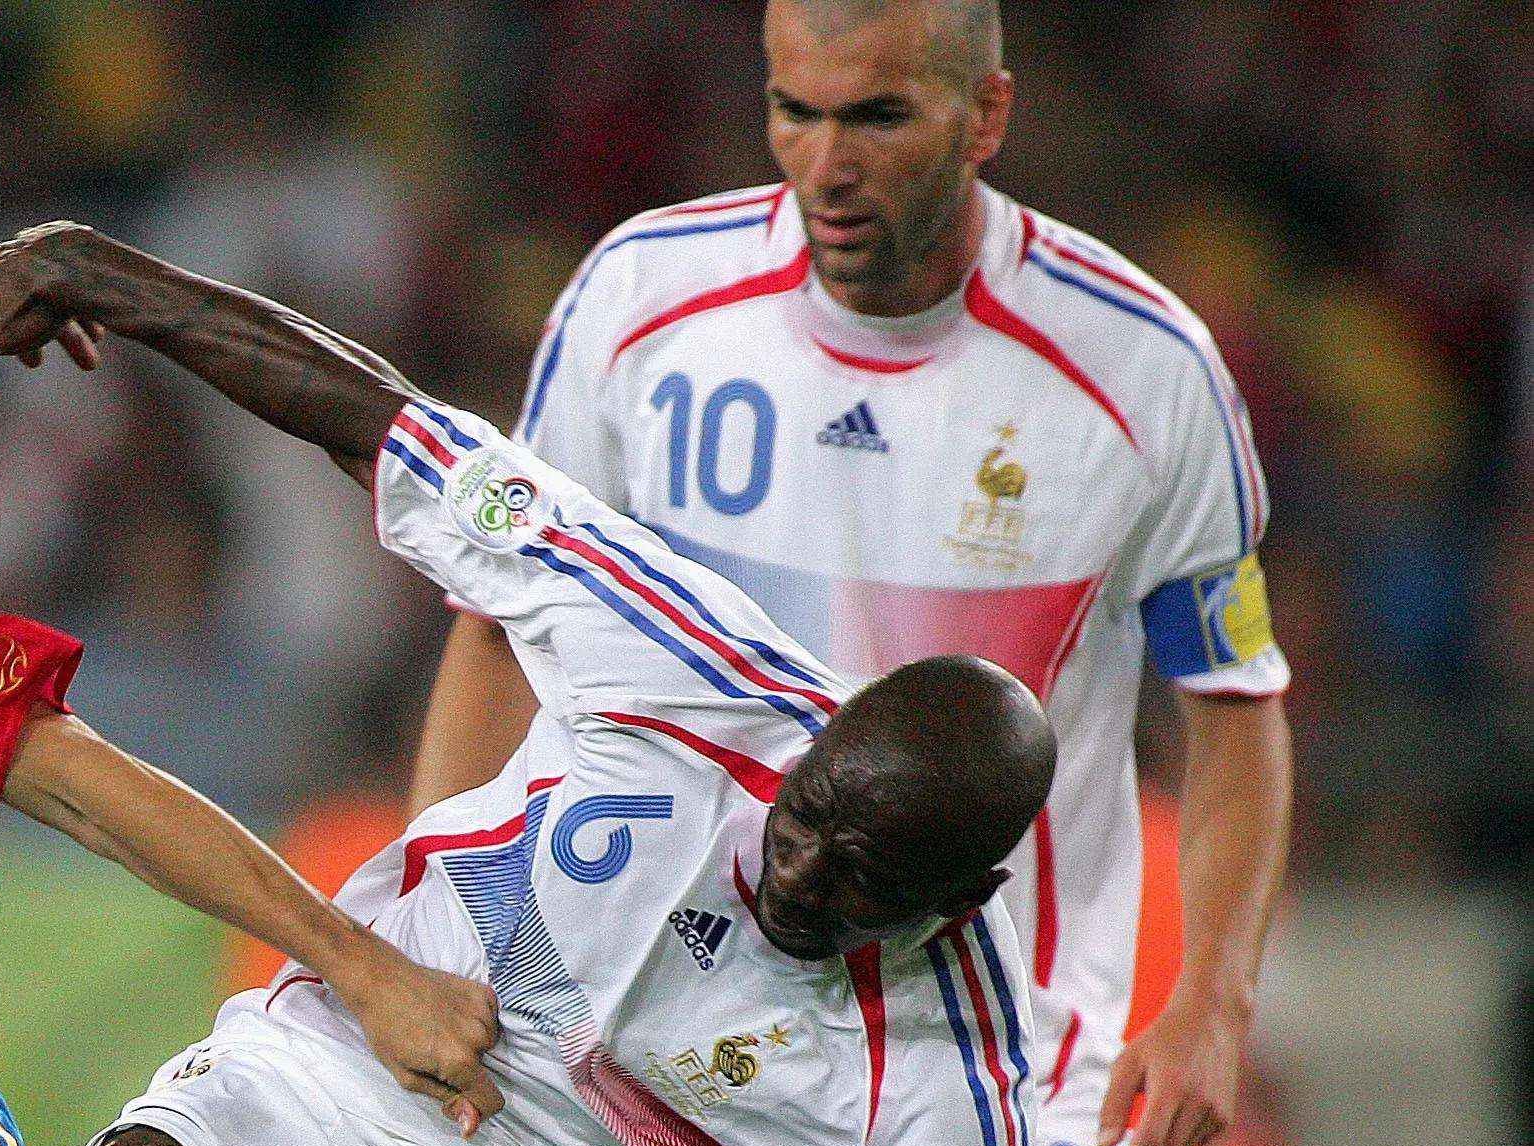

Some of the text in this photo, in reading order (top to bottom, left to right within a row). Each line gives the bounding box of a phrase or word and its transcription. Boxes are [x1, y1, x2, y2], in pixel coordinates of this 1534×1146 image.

[651, 372, 776, 514] 10
[551, 794, 674, 884] 6
[668, 910, 714, 971] adidas
